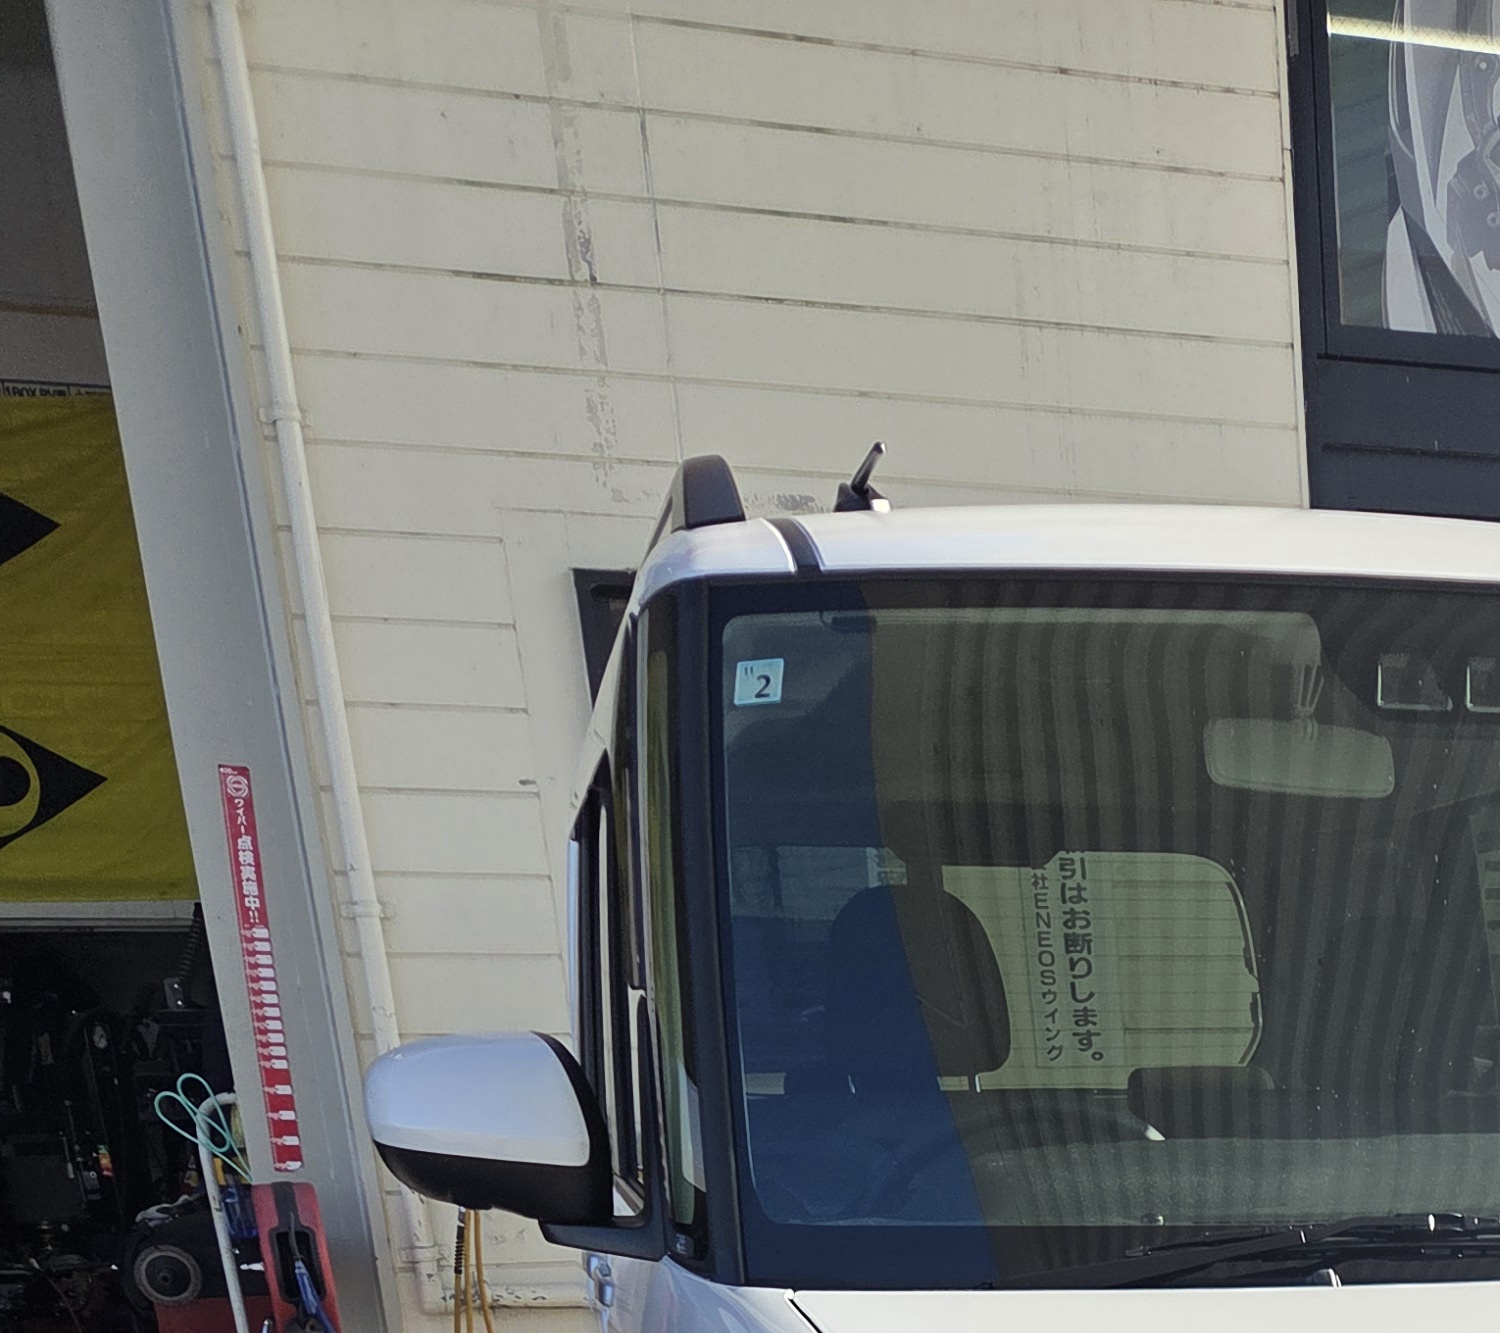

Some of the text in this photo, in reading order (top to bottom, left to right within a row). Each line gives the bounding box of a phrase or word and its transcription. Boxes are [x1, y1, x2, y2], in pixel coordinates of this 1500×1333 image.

[754, 673, 771, 699] 2
[1030, 870, 1064, 1062] 社ENEOSウイング
[1058, 853, 1105, 1062] 引はお断りします。
